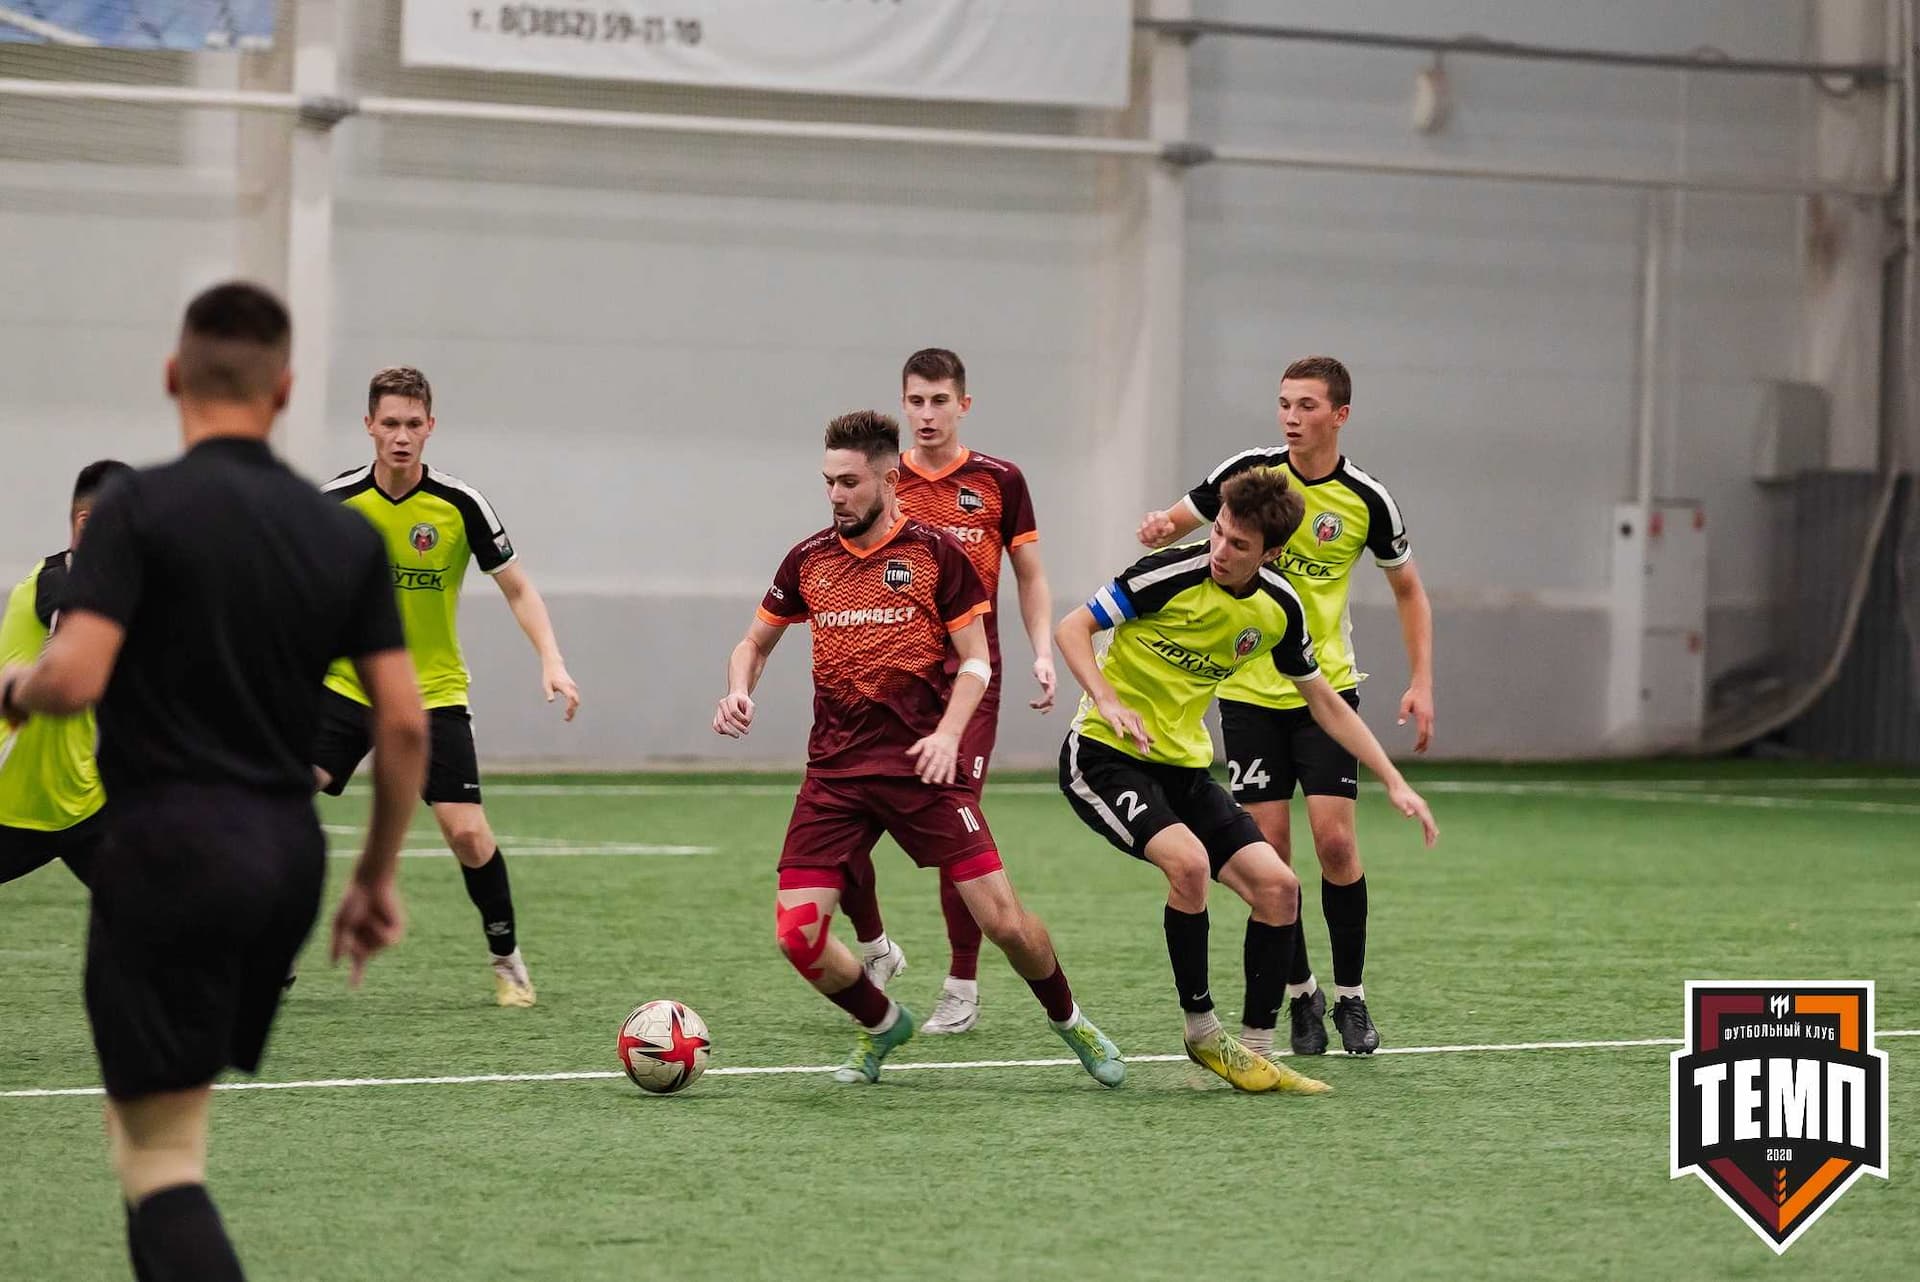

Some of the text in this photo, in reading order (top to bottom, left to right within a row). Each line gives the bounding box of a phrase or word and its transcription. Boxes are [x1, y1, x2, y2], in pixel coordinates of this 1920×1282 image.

[886, 569, 910, 583] ТЕМП
[972, 755, 985, 779] 9
[1227, 758, 1271, 792] 24
[957, 806, 980, 833] 10
[1115, 790, 1149, 822] 2
